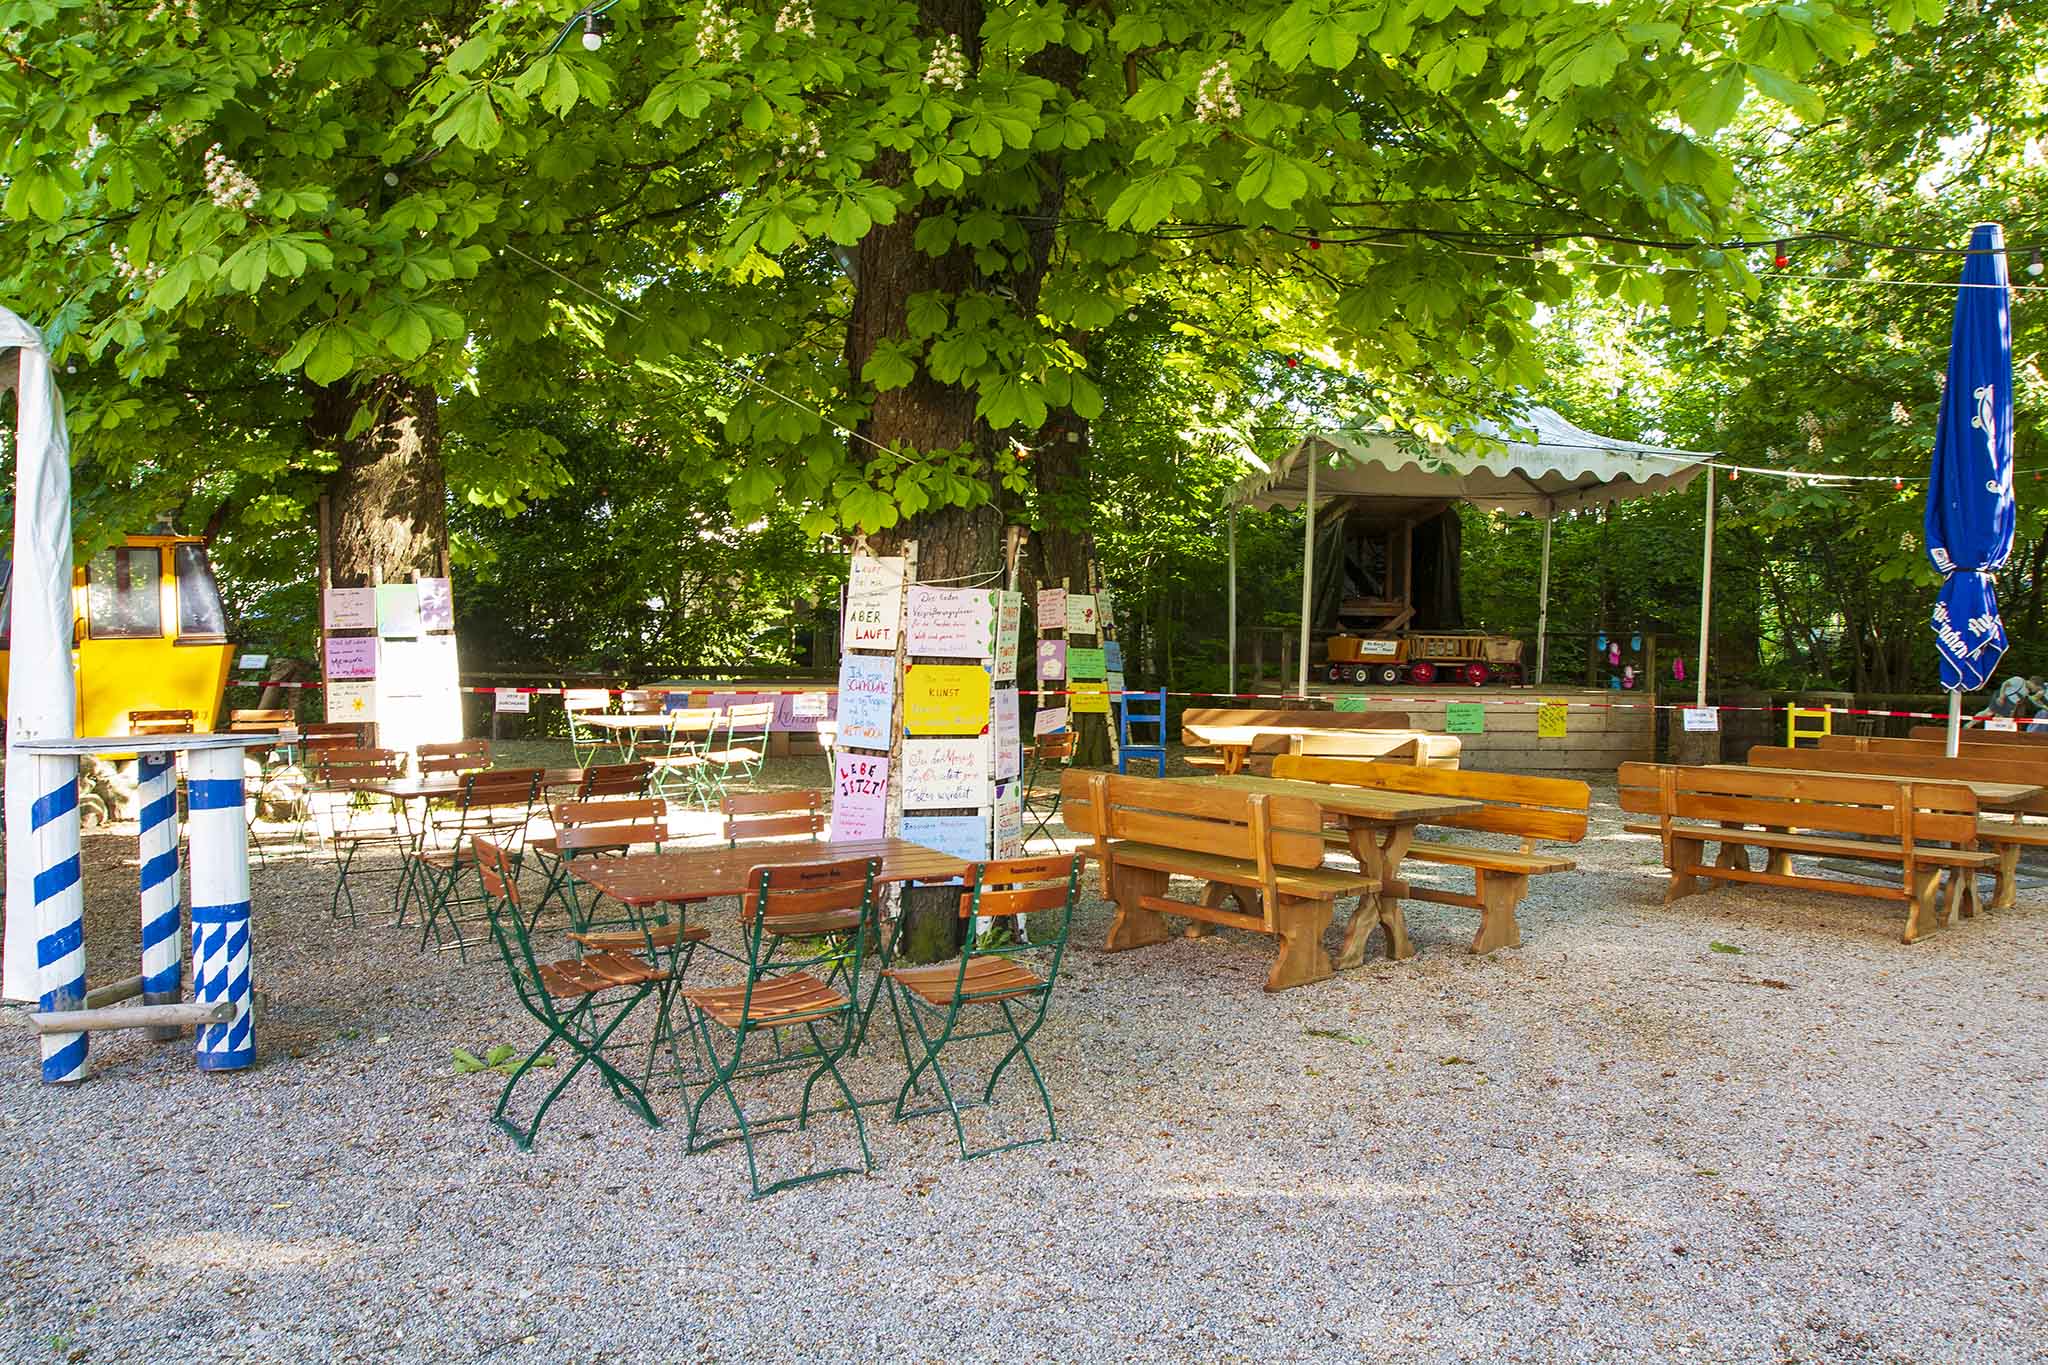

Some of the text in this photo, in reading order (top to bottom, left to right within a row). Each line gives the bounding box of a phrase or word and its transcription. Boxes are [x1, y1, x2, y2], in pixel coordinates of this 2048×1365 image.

[850, 610, 880, 623] ABER
[929, 688, 960, 697] KUNST
[841, 763, 877, 779] LEBE
[841, 779, 885, 798] JETZT!
